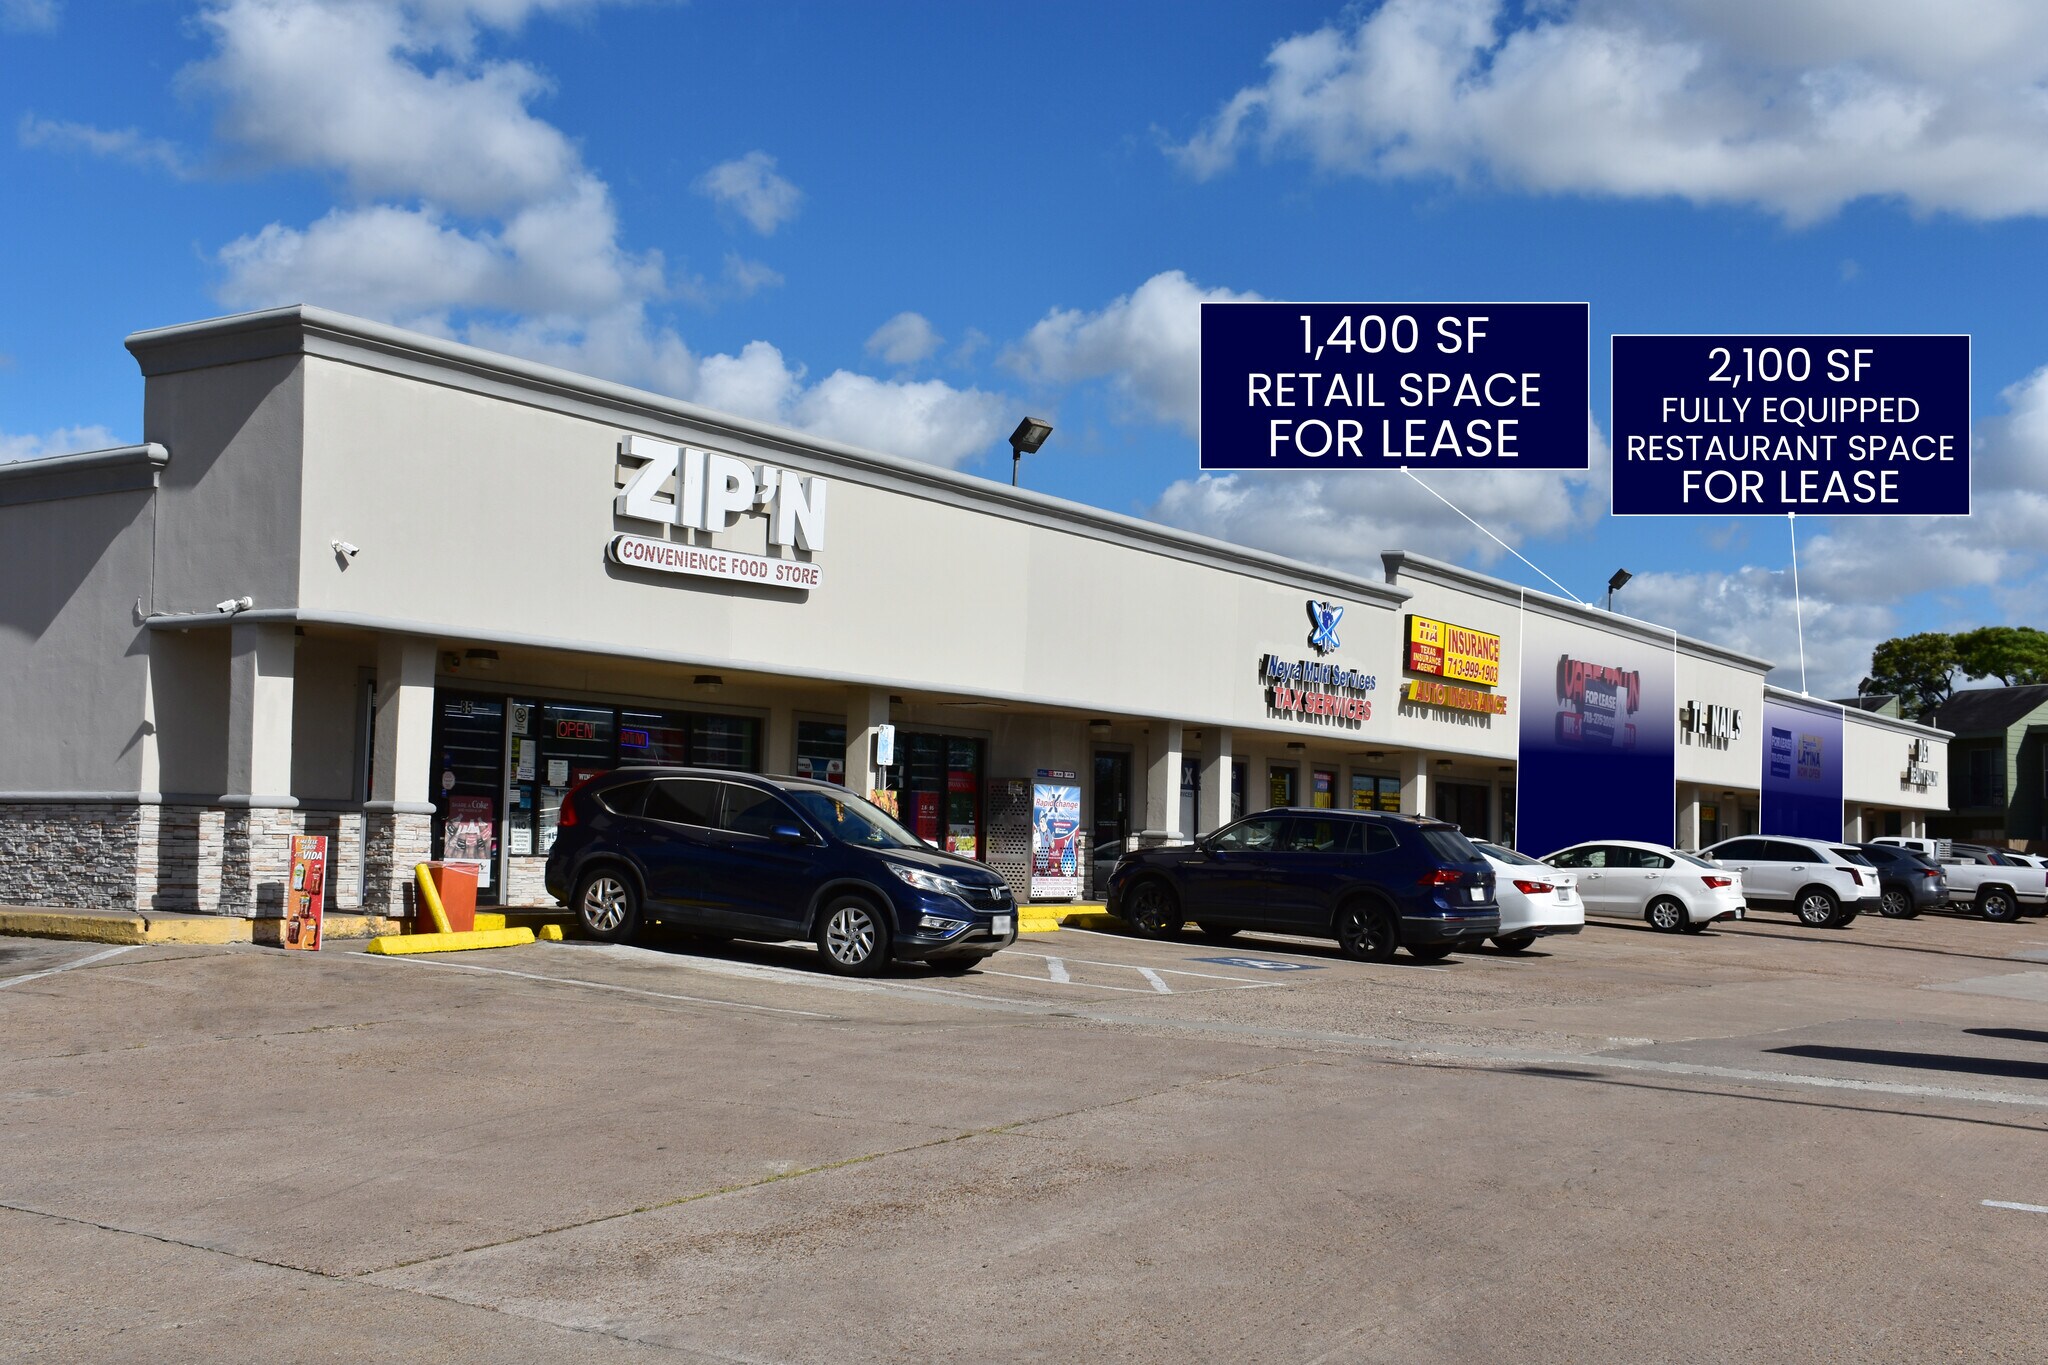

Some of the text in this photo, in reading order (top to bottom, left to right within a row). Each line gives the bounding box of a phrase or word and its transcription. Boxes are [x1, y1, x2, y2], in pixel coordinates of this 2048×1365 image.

[618, 434, 827, 552] ZIP'N
[623, 541, 819, 585] CONVENIENCE FOOD STORE
[1420, 645, 1437, 655] TEXAS
[1448, 628, 1499, 662] INSURANCE
[1413, 652, 1441, 666] INSURANCE
[1416, 663, 1437, 674] AGENCY
[1448, 657, 1498, 682] 713-999-1903
[1268, 655, 1376, 691] Neyra Multi Services
[1273, 686, 1372, 721] TAX SERVICES
[1414, 680, 1507, 715] AUTO INSURANCE
[1585, 690, 1617, 709] FOR LEASE
[558, 721, 593, 739] OPEN
[1711, 705, 1743, 740] NAILS
[471, 800, 489, 809] Coke
[303, 851, 323, 860] VIDA
